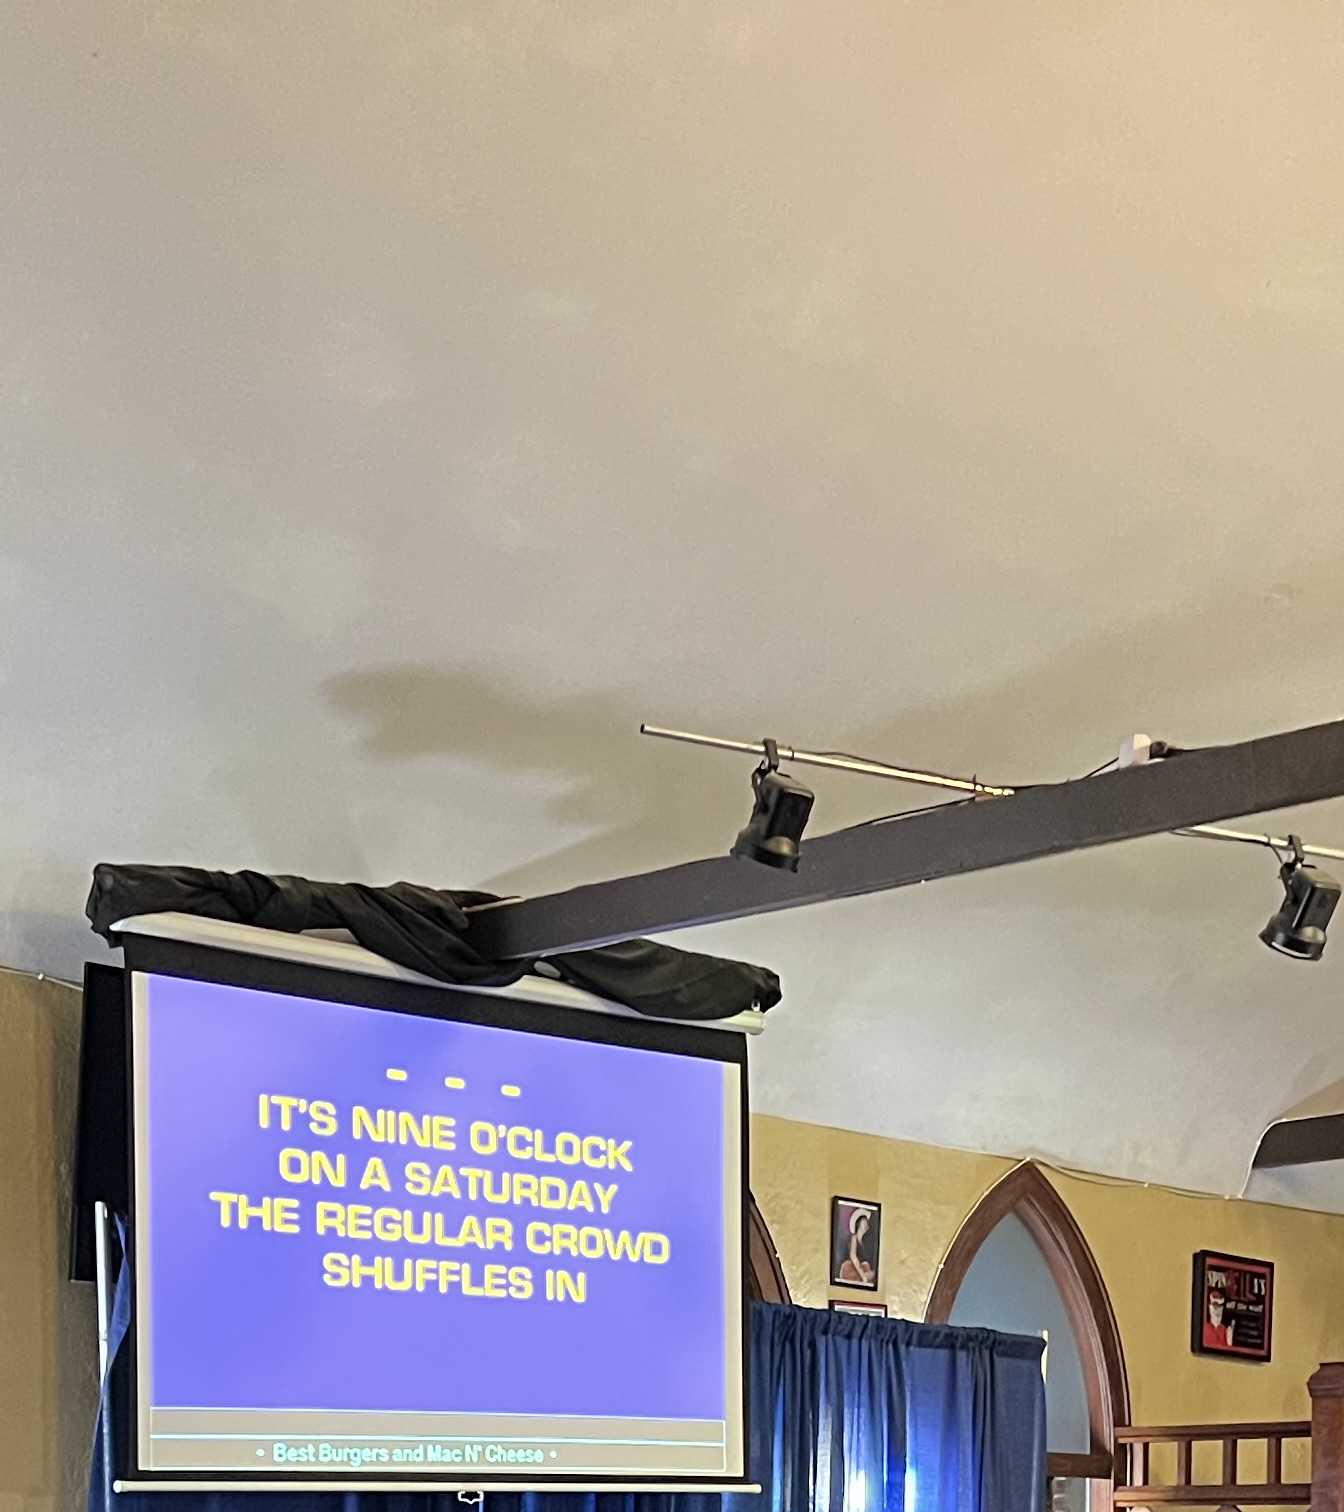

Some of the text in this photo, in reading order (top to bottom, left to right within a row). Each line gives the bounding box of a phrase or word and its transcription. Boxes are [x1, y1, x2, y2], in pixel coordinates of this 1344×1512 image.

[258, 1094, 633, 1172] IT'S NINE O'CLOCK
[278, 1148, 619, 1213] ON A SATURDAY
[210, 1191, 670, 1264] THE REGULAR CROWD
[322, 1252, 587, 1303] SHUFFLES IN
[272, 1443, 315, 1463] Best
[318, 1443, 390, 1467] Burgers
[392, 1444, 424, 1463] and
[427, 1445, 462, 1463] Mac
[485, 1445, 544, 1463] Cheese
